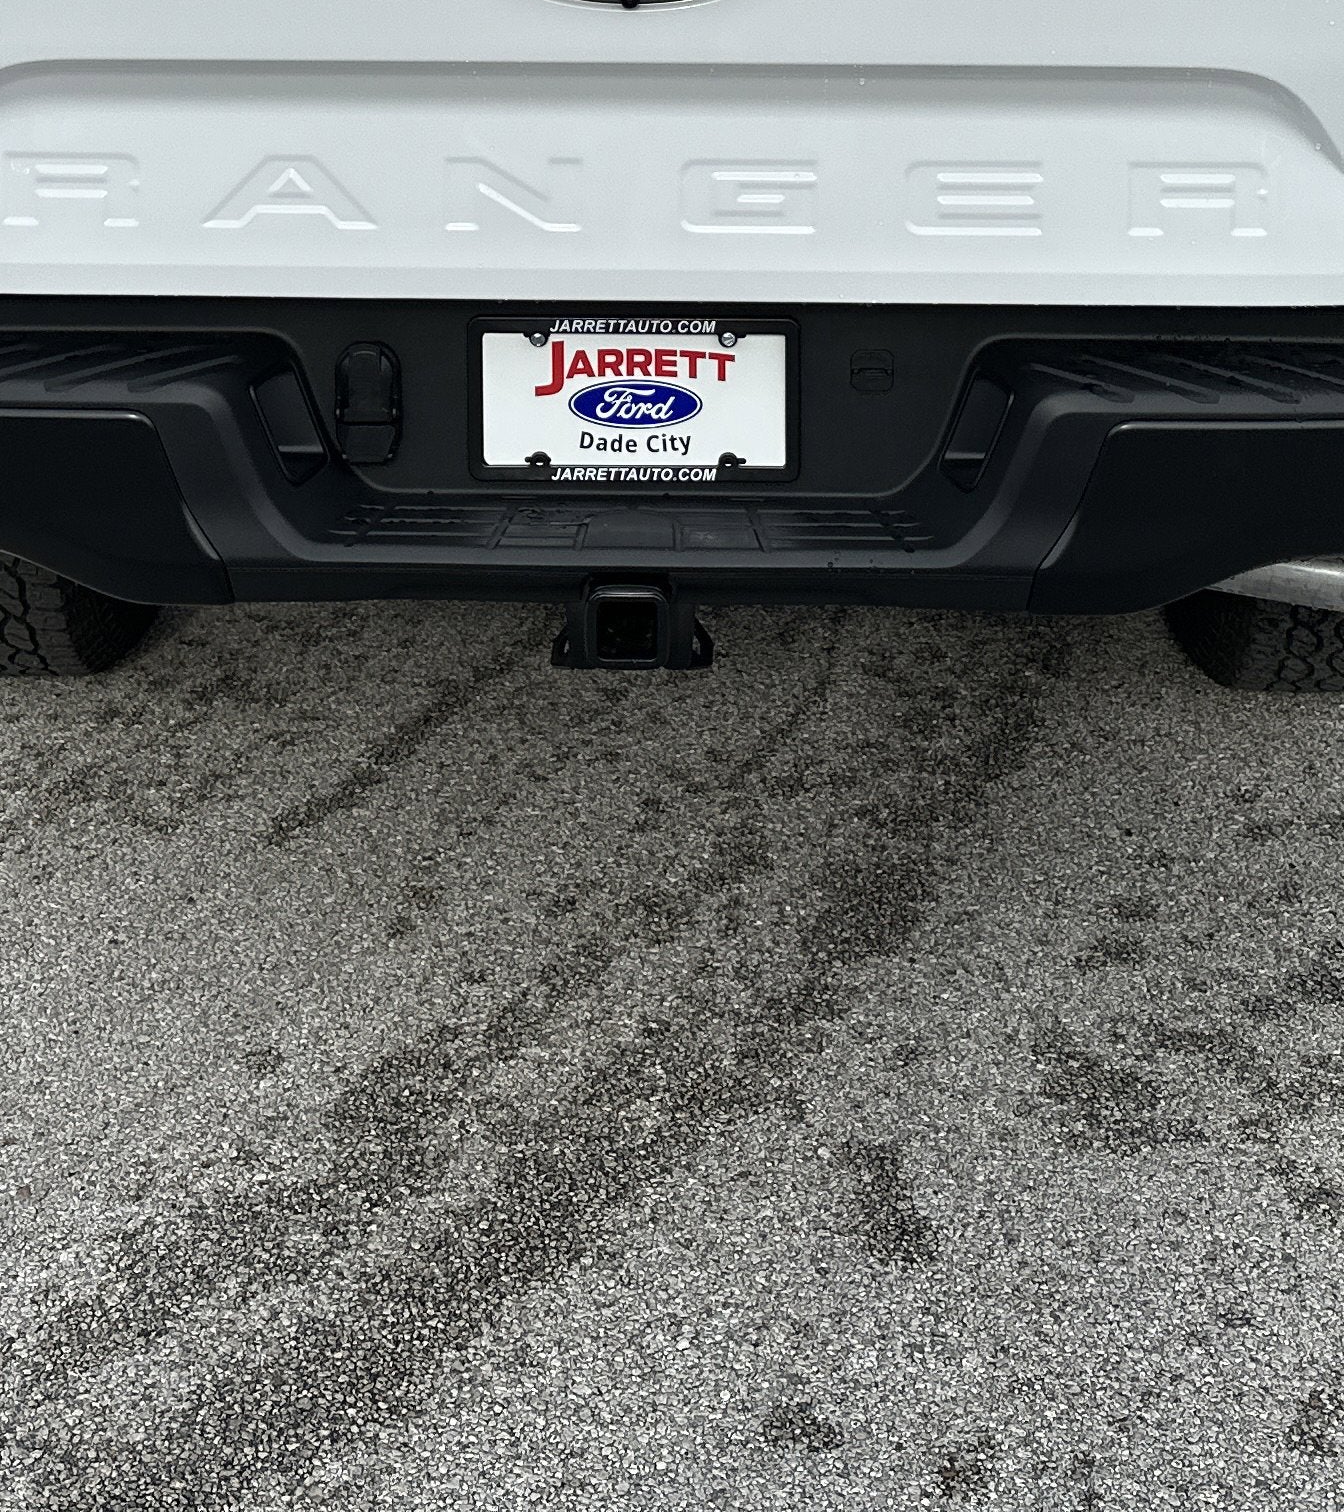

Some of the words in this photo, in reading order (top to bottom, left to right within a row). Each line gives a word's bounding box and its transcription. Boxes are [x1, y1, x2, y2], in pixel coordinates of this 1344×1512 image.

[2, 150, 1268, 237] RANGER
[549, 319, 716, 333] JARRETTAUTO.COM
[534, 340, 736, 397] JARRETT
[595, 387, 674, 420] Ford
[579, 431, 638, 453] Dade
[646, 433, 692, 455] City
[551, 467, 717, 481] JARRETTAUTO.COM
